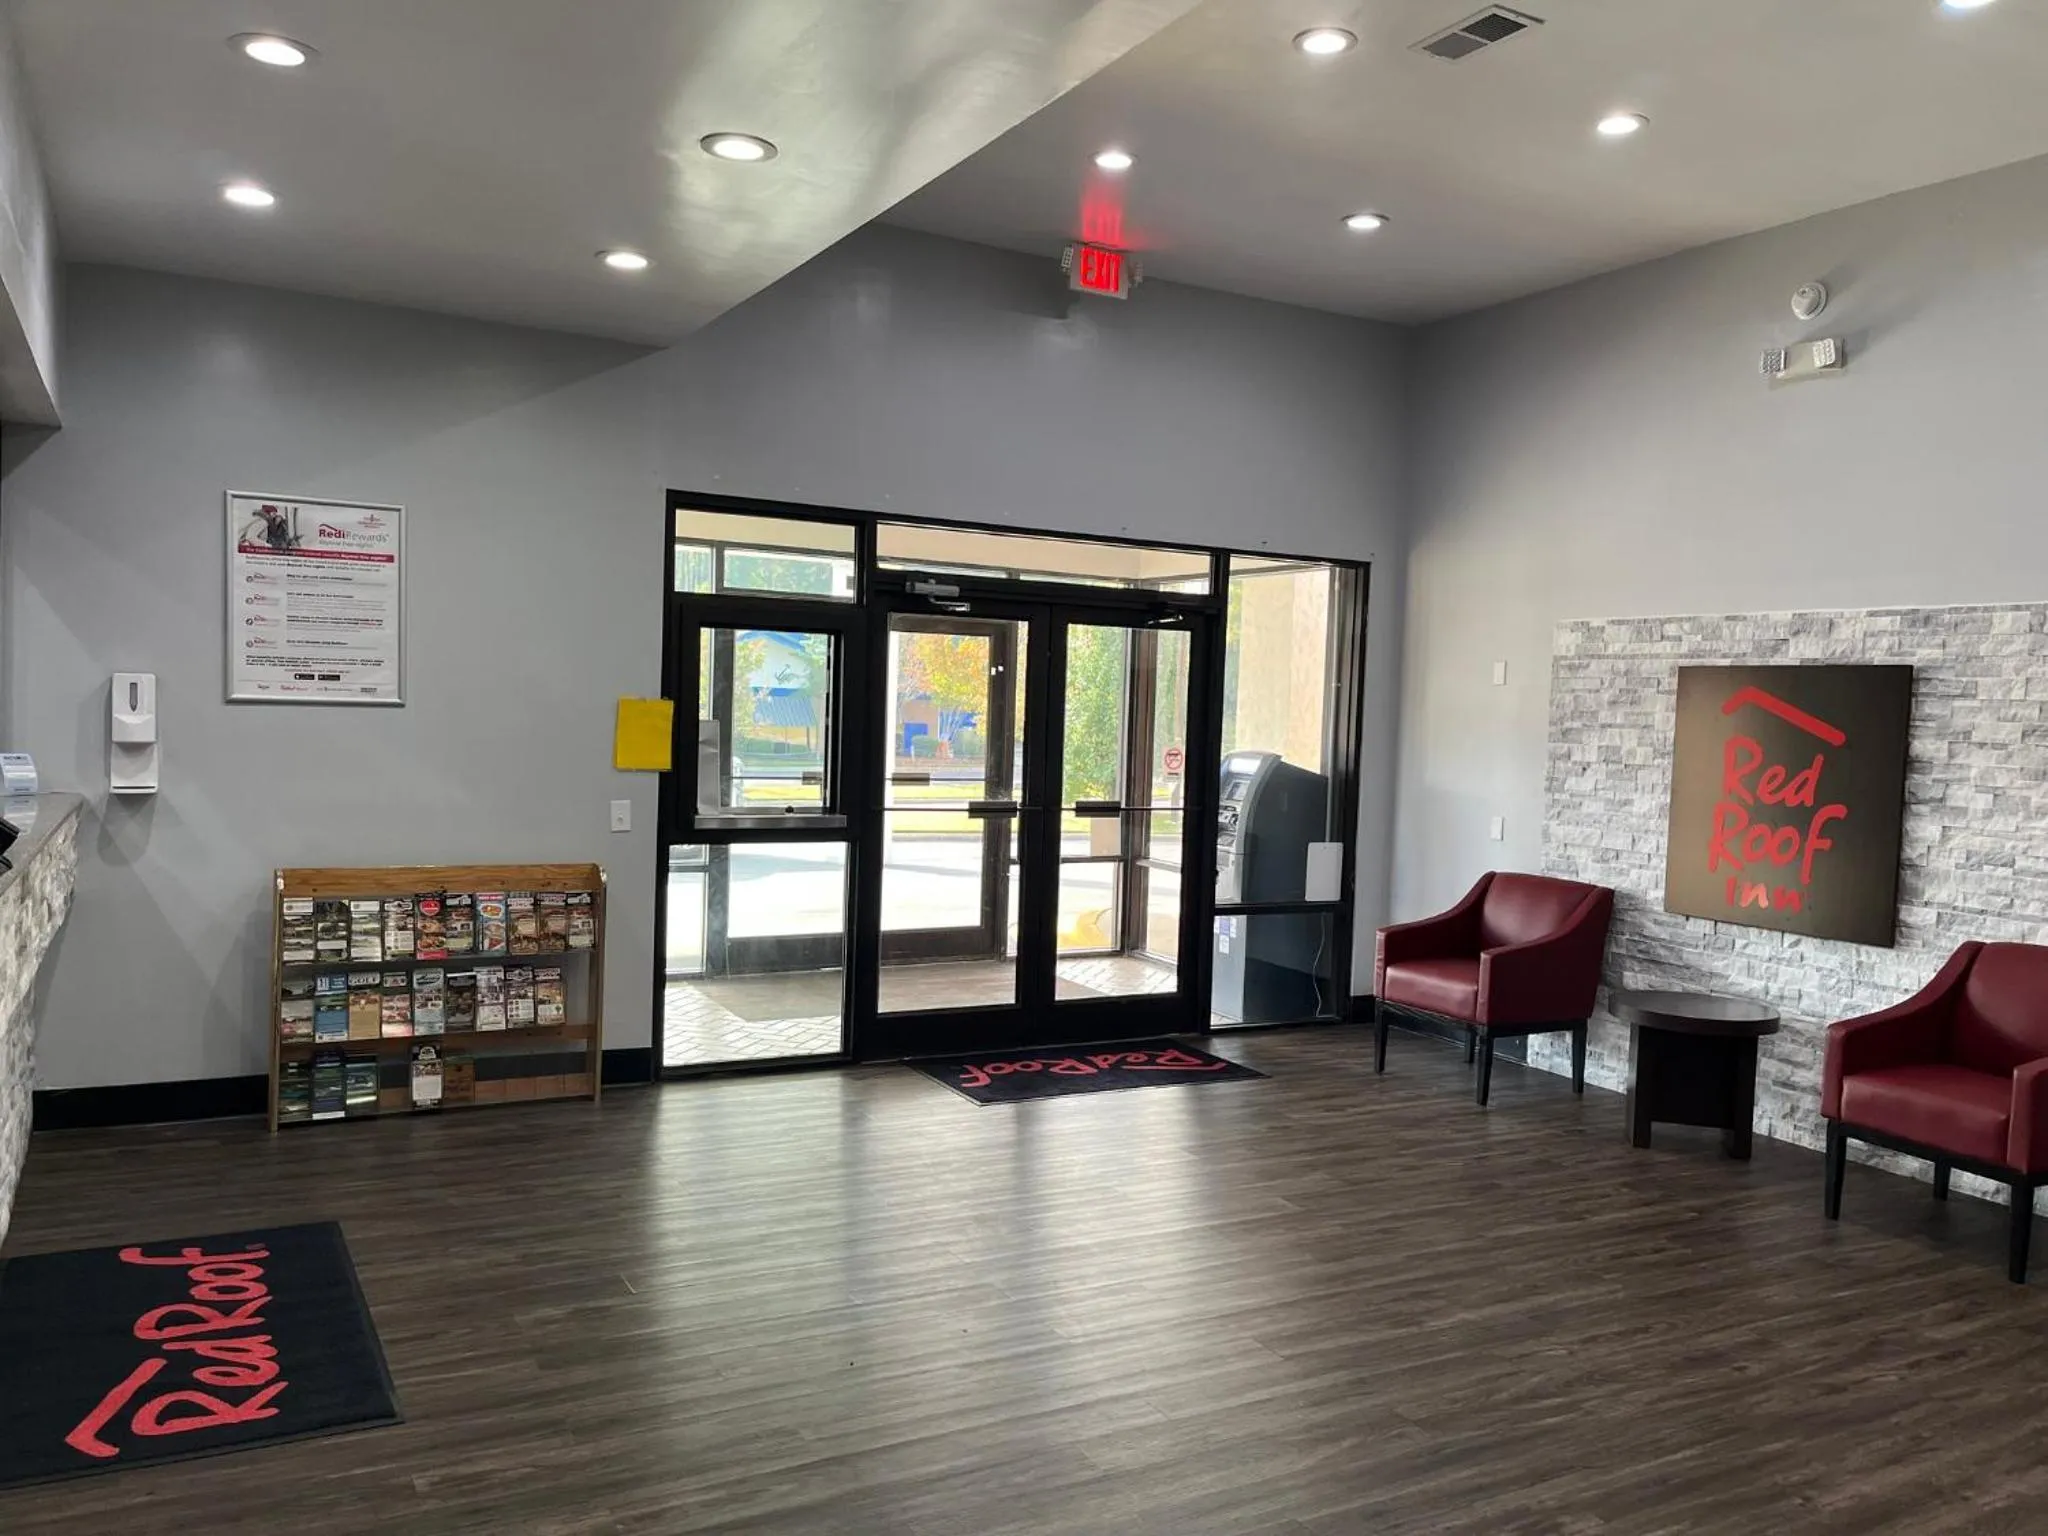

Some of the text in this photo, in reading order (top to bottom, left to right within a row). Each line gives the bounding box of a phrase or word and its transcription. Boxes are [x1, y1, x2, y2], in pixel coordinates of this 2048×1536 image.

[1080, 247, 1123, 293] EXIT
[1722, 734, 1824, 808] Red
[1707, 802, 1848, 888] Roof
